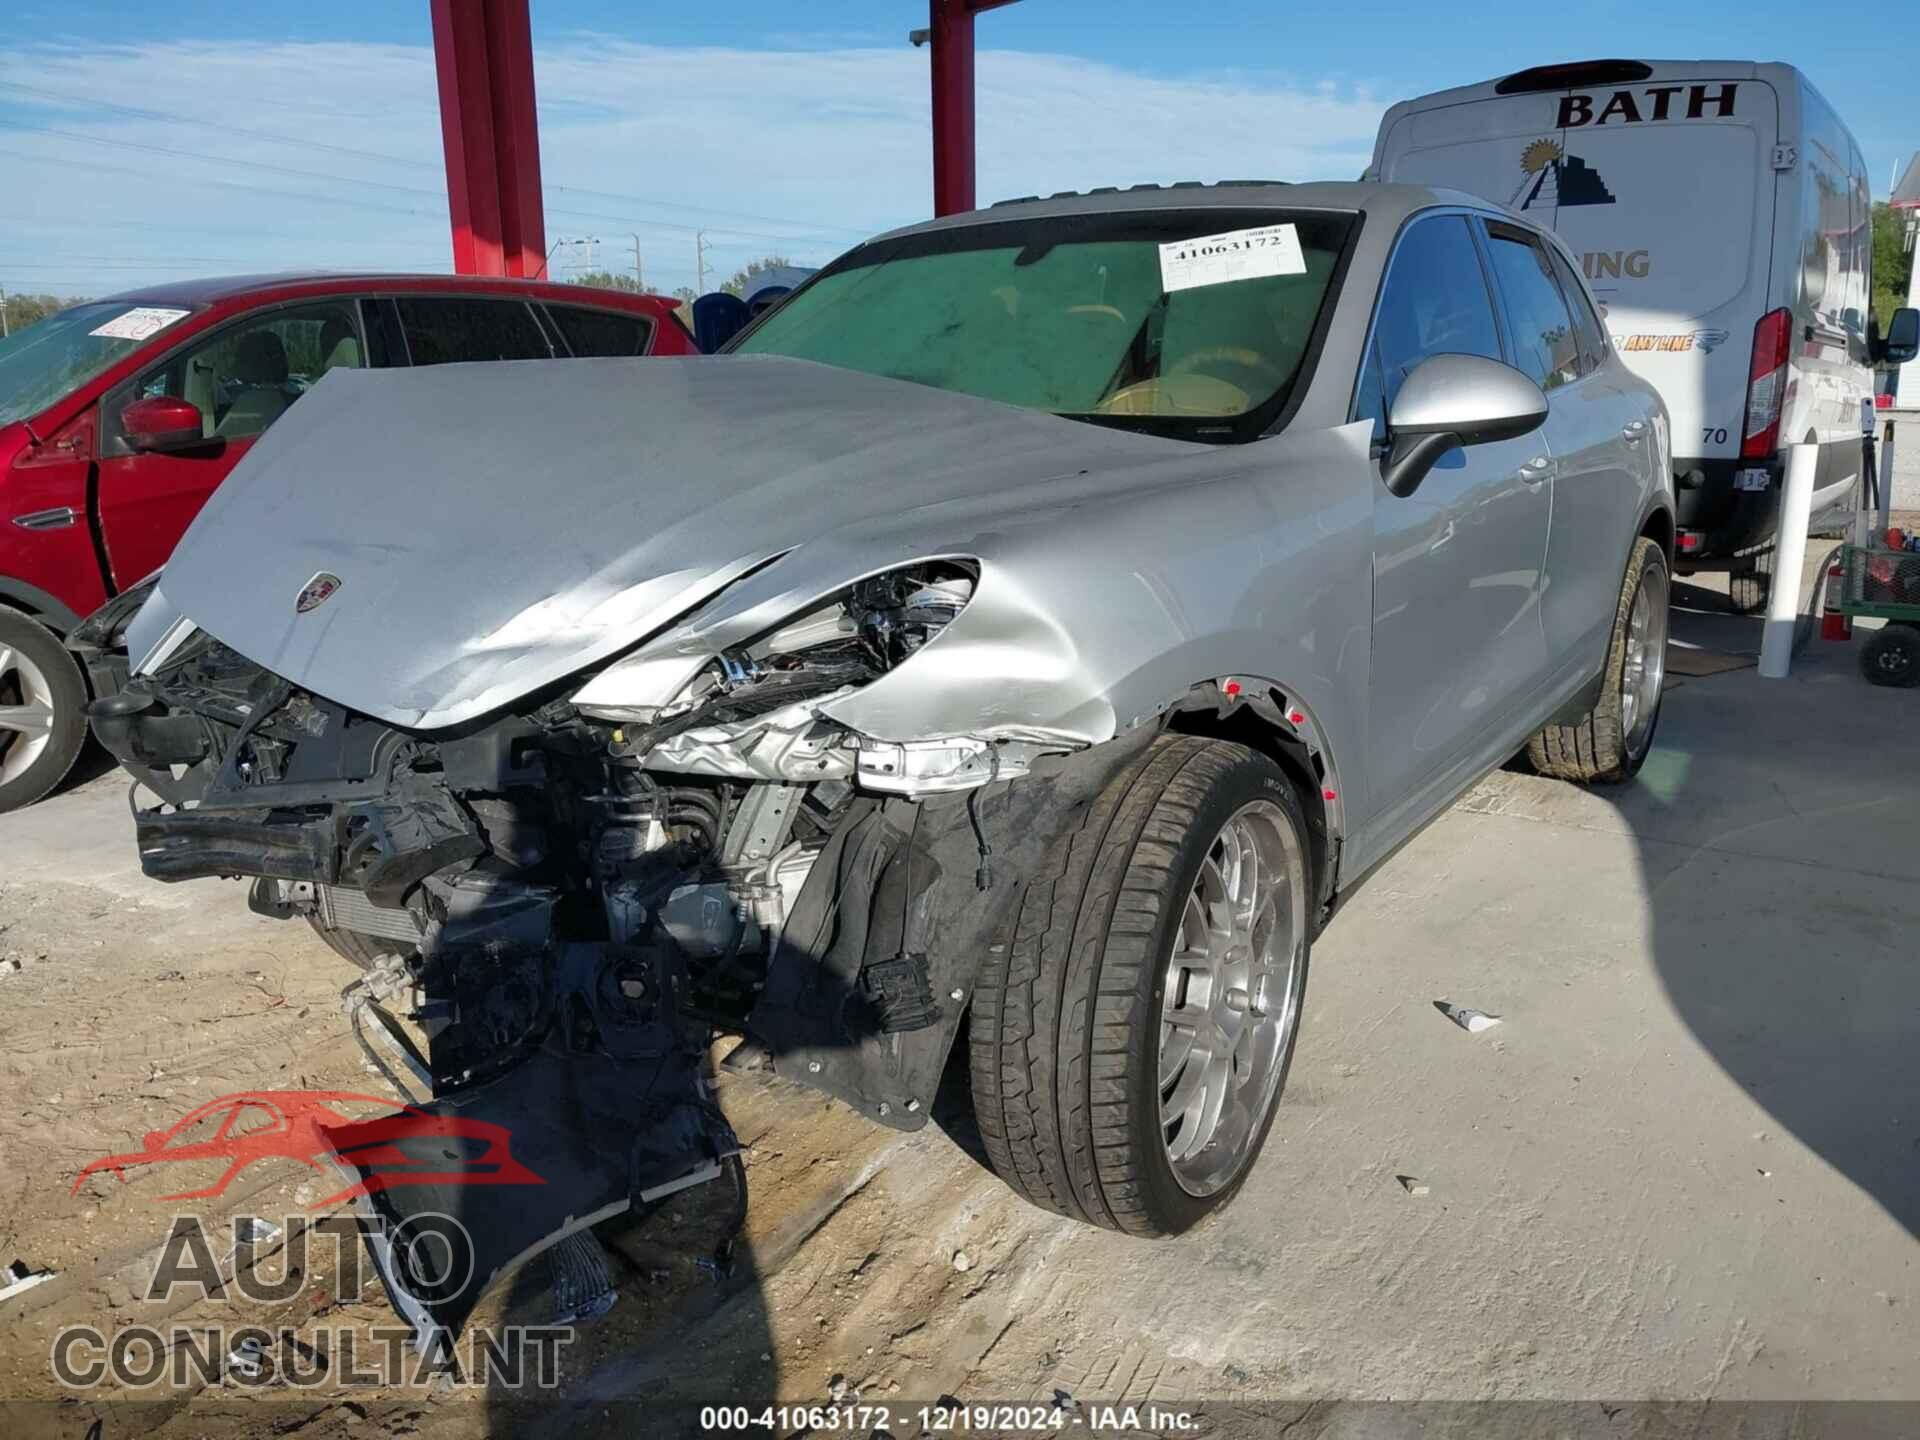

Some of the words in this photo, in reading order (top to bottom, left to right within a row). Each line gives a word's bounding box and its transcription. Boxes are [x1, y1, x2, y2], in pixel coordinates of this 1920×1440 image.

[1555, 83, 1738, 128] BATH
[1174, 236, 1282, 260] 41063172
[1575, 249, 1650, 279] ING
[1703, 427, 1728, 445] 70
